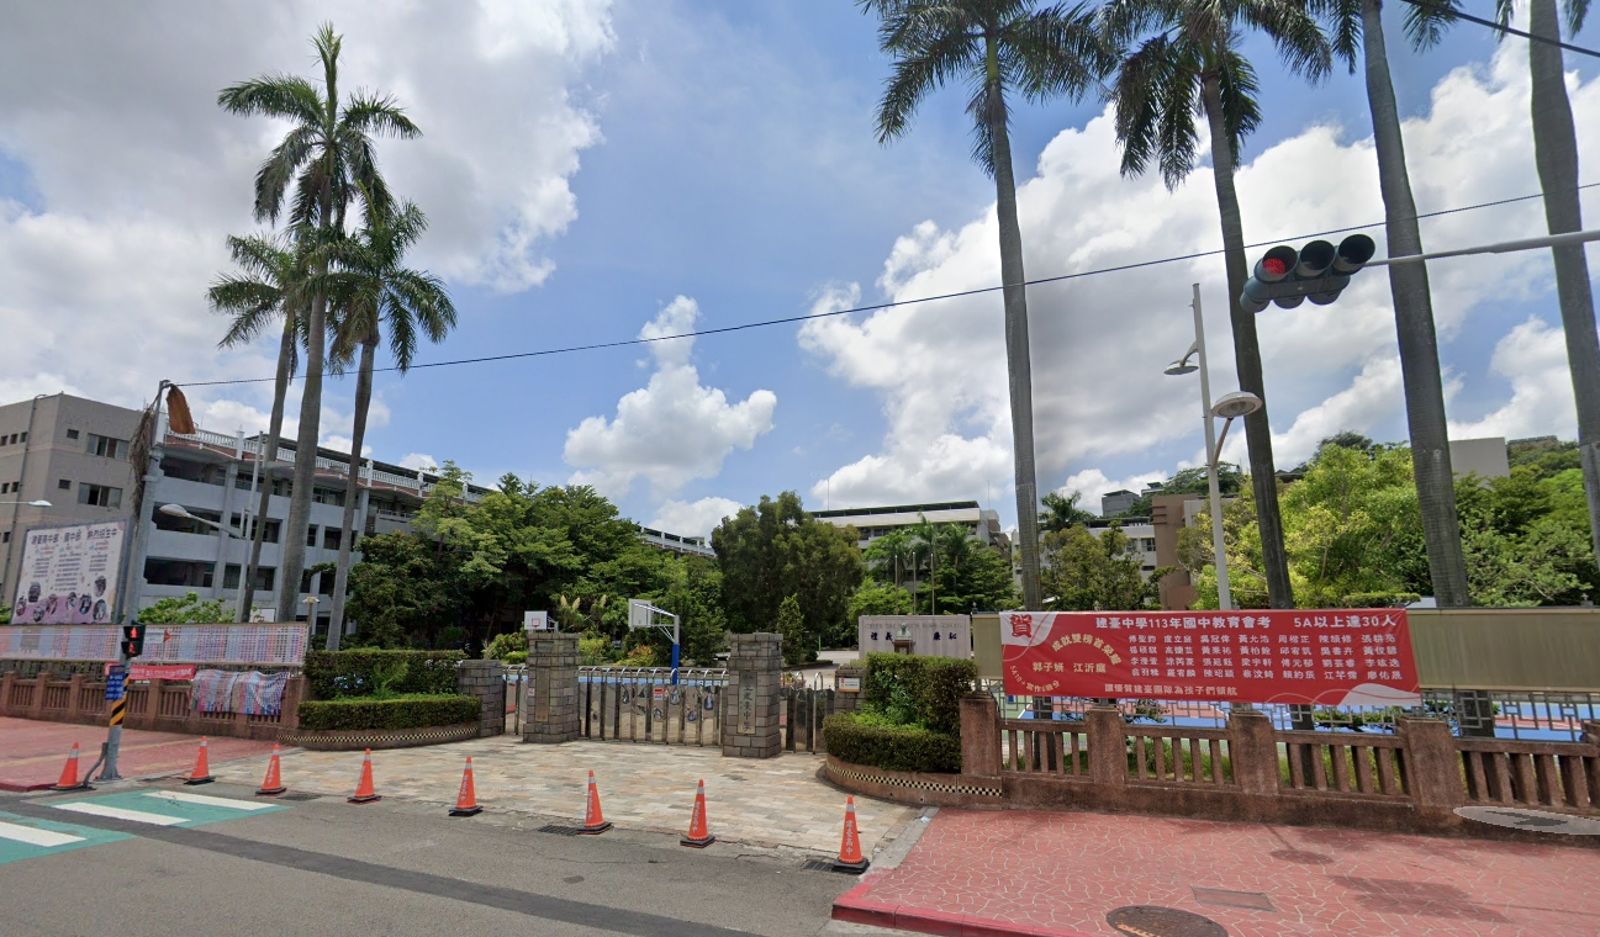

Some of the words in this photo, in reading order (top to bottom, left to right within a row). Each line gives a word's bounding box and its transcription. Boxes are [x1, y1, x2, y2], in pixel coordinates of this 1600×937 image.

[1010, 614, 1032, 638] 賀
[1096, 616, 1271, 629] 建臺中學113年國中教育會考
[1294, 615, 1396, 628] 5A以上達30人
